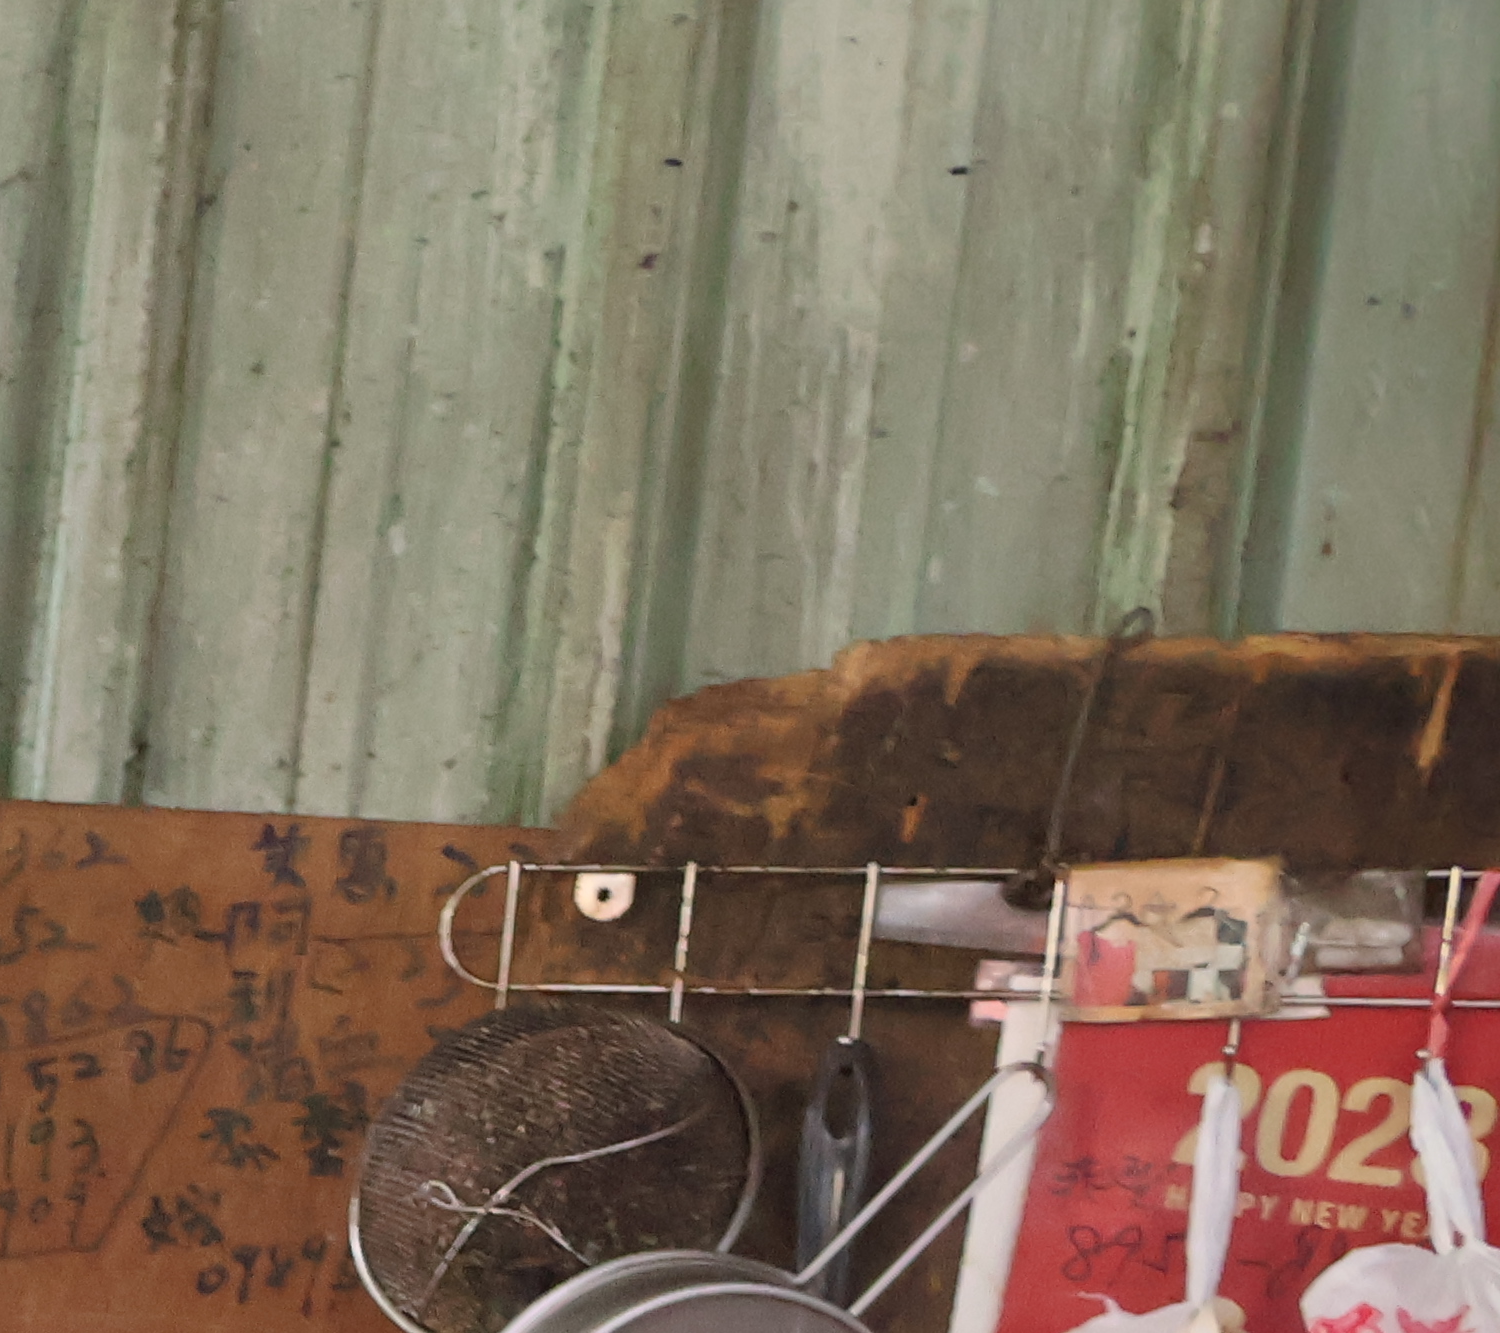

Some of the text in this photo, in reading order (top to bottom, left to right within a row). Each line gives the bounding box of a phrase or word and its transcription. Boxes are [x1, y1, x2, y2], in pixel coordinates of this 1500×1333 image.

[1164, 1183, 1431, 1238] HPY NEW YE
